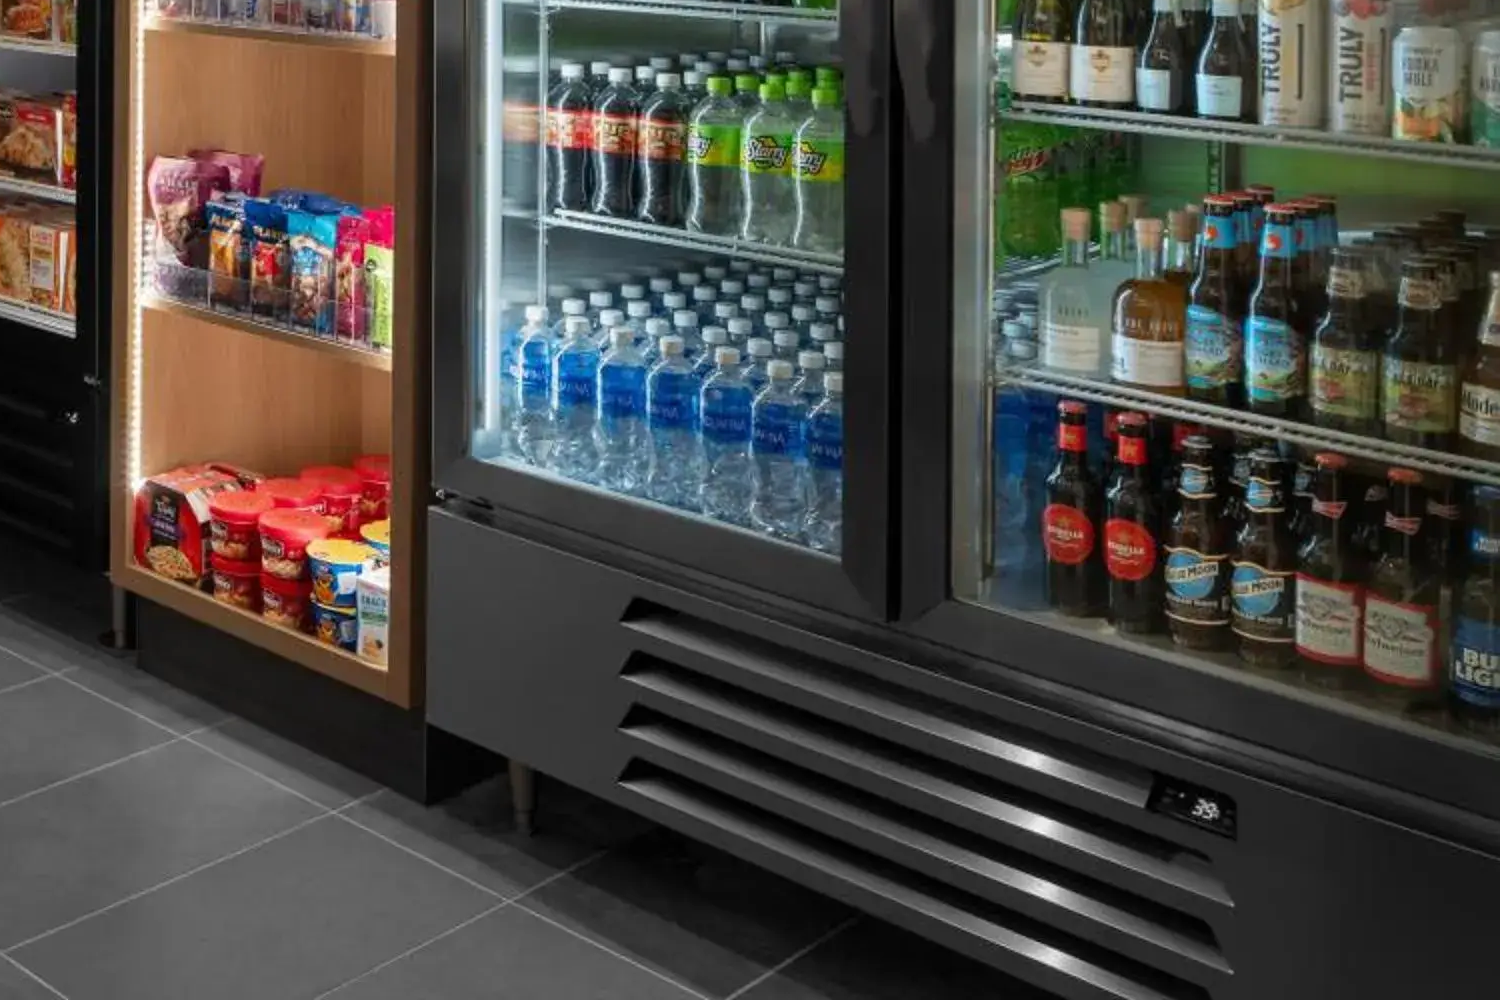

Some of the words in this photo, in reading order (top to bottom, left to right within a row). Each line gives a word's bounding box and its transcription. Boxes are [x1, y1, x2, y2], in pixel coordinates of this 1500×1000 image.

[1261, 21, 1281, 95] TRULY
[1339, 26, 1364, 102] TRULY
[1187, 563, 1218, 577] MOON
[1463, 647, 1500, 668] BU
